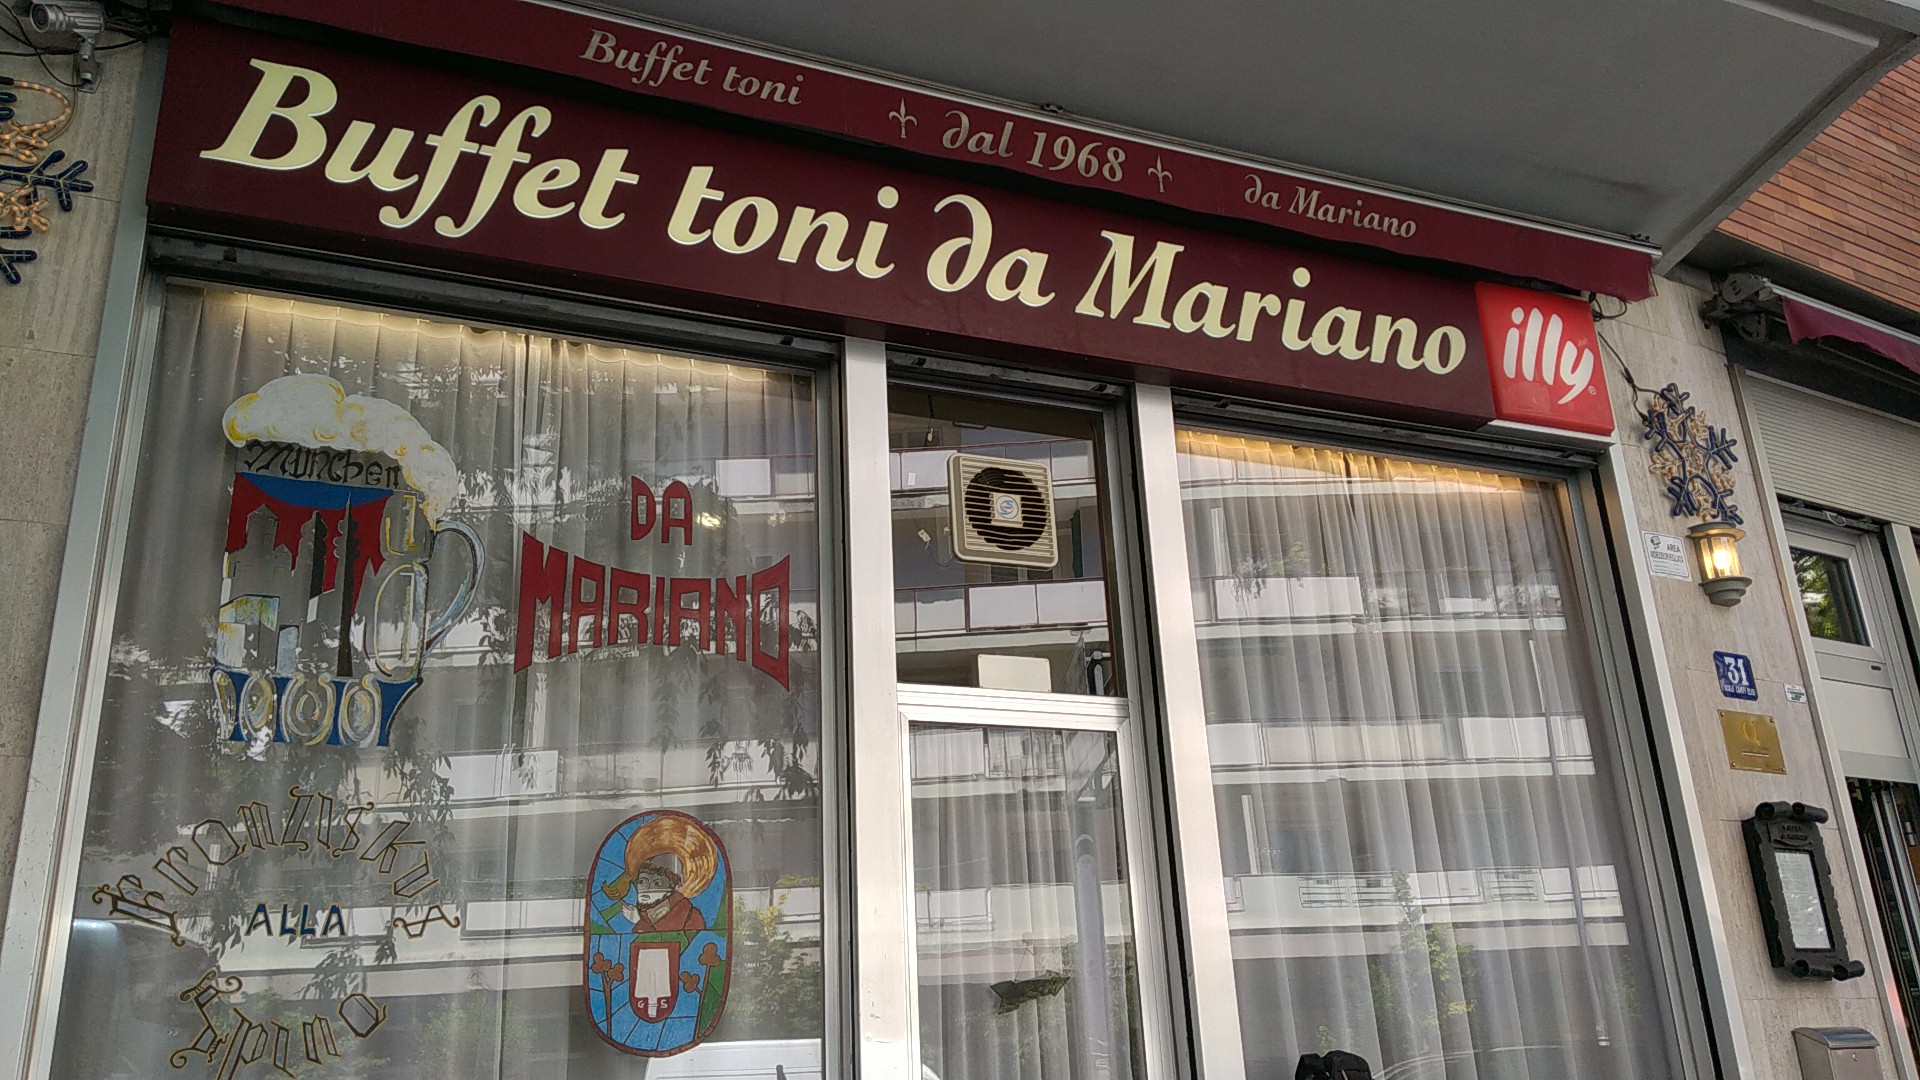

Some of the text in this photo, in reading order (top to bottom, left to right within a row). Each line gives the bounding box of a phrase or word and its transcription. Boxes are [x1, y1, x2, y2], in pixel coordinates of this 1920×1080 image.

[579, 29, 1417, 238] Buffet toni dal 1968 da Mariano
[200, 58, 1466, 375] Buffet toni da Mariano
[1503, 306, 1595, 405] illy
[631, 475, 693, 545] DA
[513, 530, 790, 693] MARIANO
[1723, 656, 1750, 686] 31
[244, 903, 346, 937] ALLA
